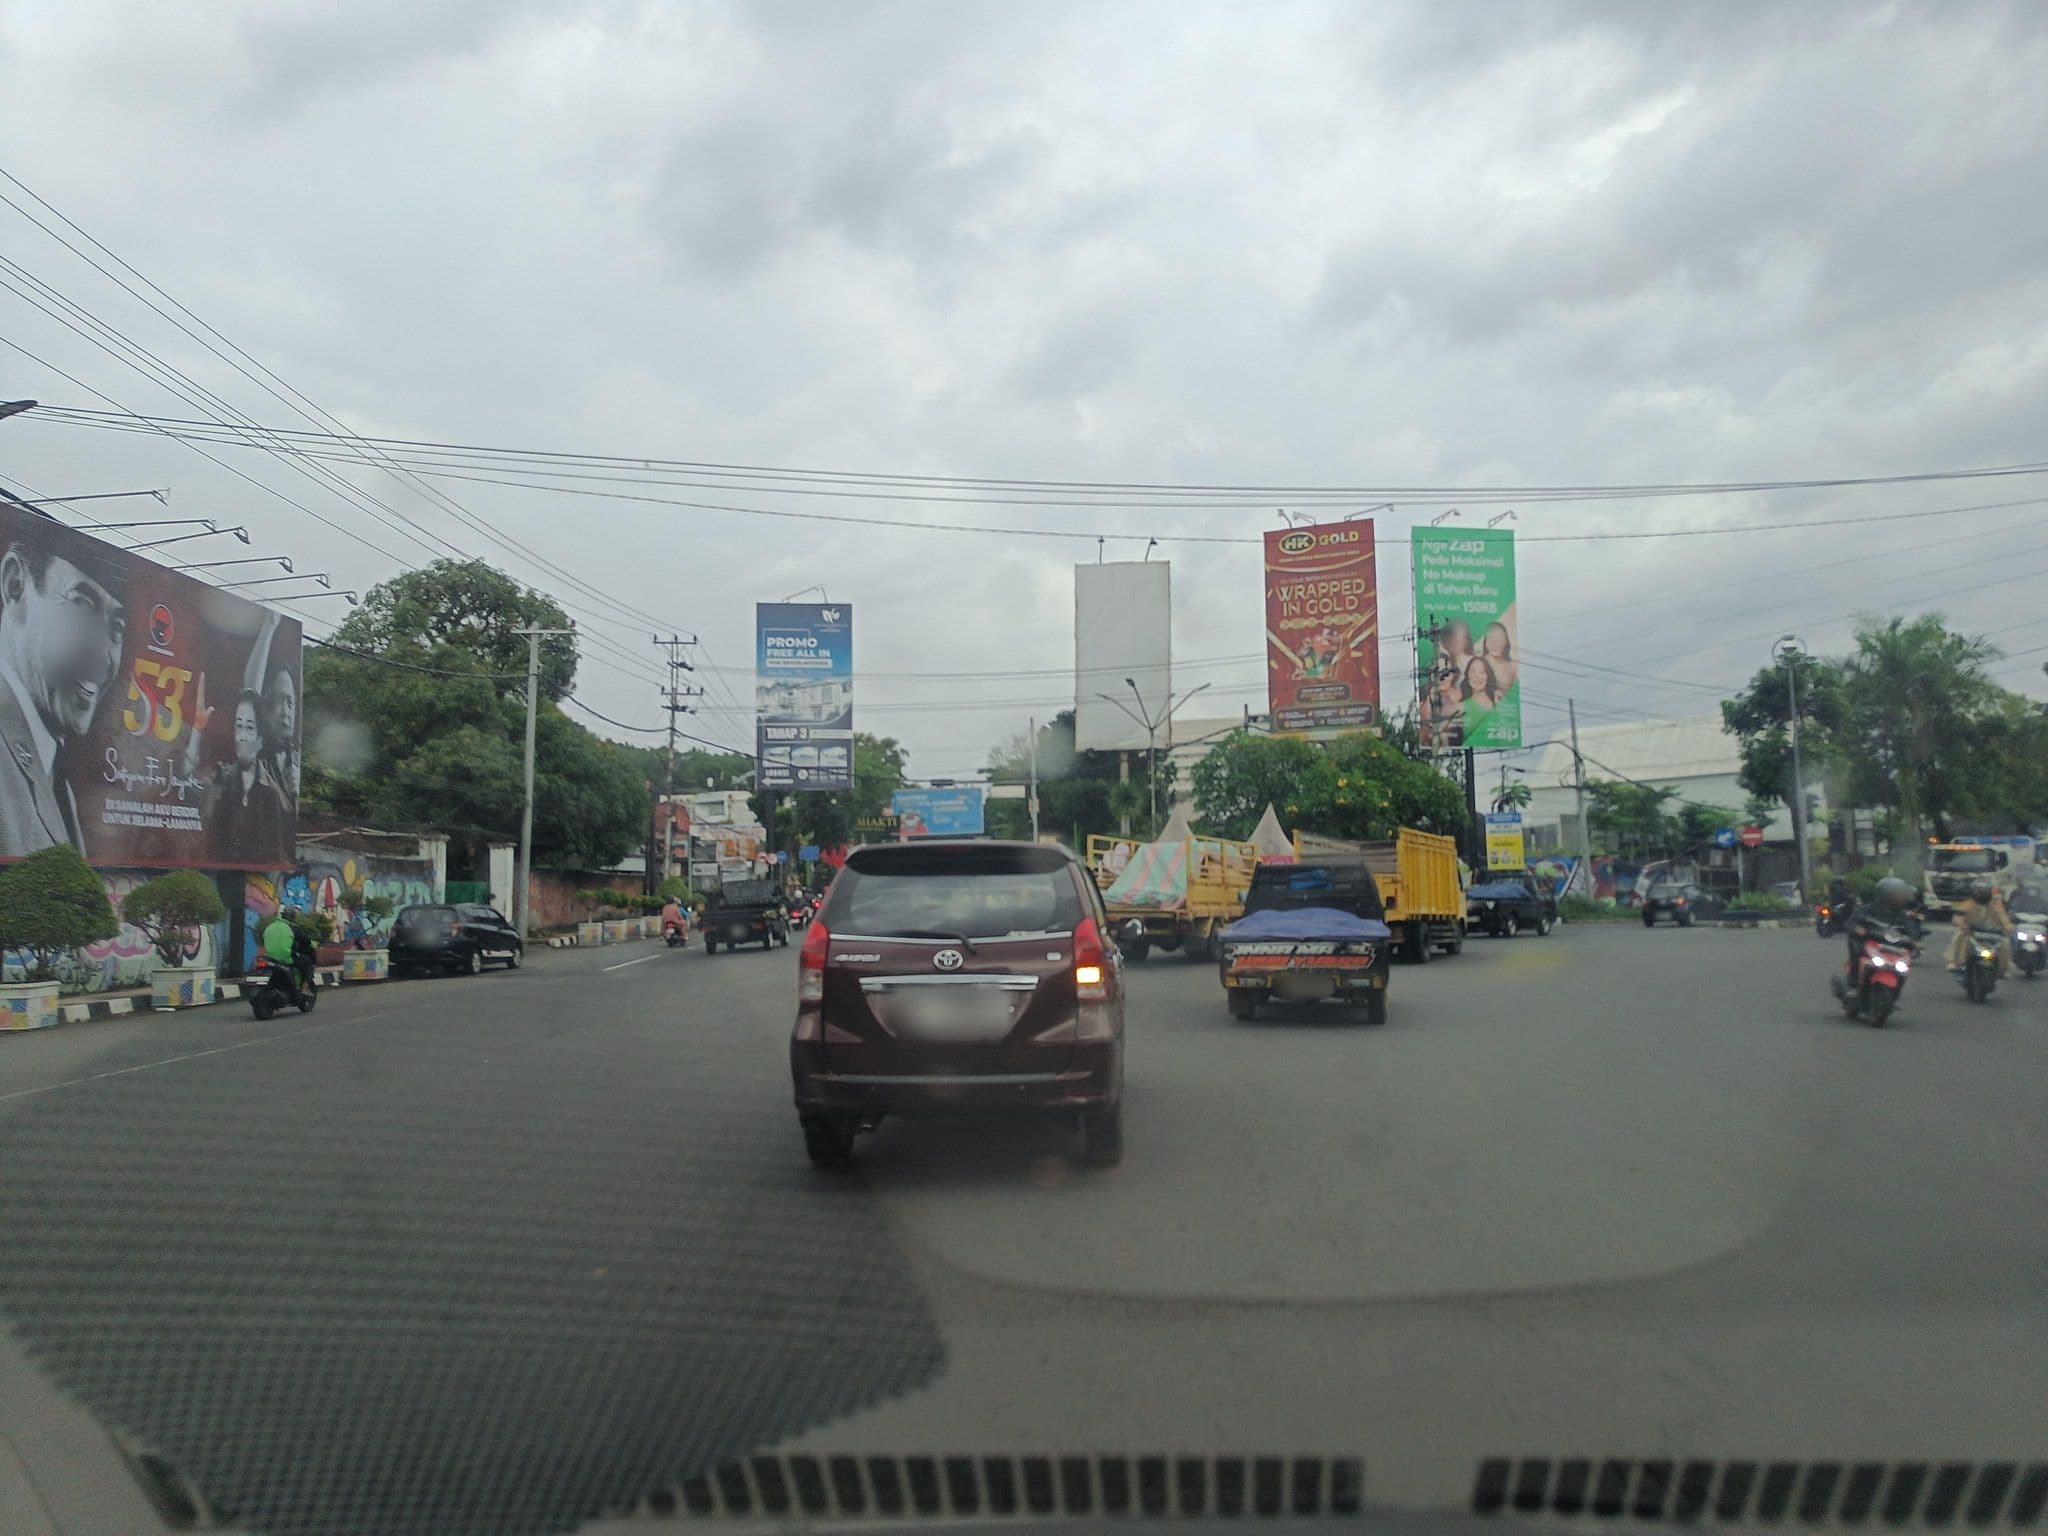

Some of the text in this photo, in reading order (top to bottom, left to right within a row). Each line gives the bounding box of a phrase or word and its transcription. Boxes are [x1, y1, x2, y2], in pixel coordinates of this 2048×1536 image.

[1284, 531, 1359, 549] HK GOLD
[1423, 569, 1440, 580] No
[1275, 578, 1366, 602] WRAPPED
[1423, 583, 1434, 594] di
[1436, 584, 1471, 595] Tahun
[1283, 595, 1359, 616] IN GOLD
[767, 637, 818, 648] PROMO
[767, 649, 831, 657] FREE ALL IN
[1487, 727, 1519, 742] zap
